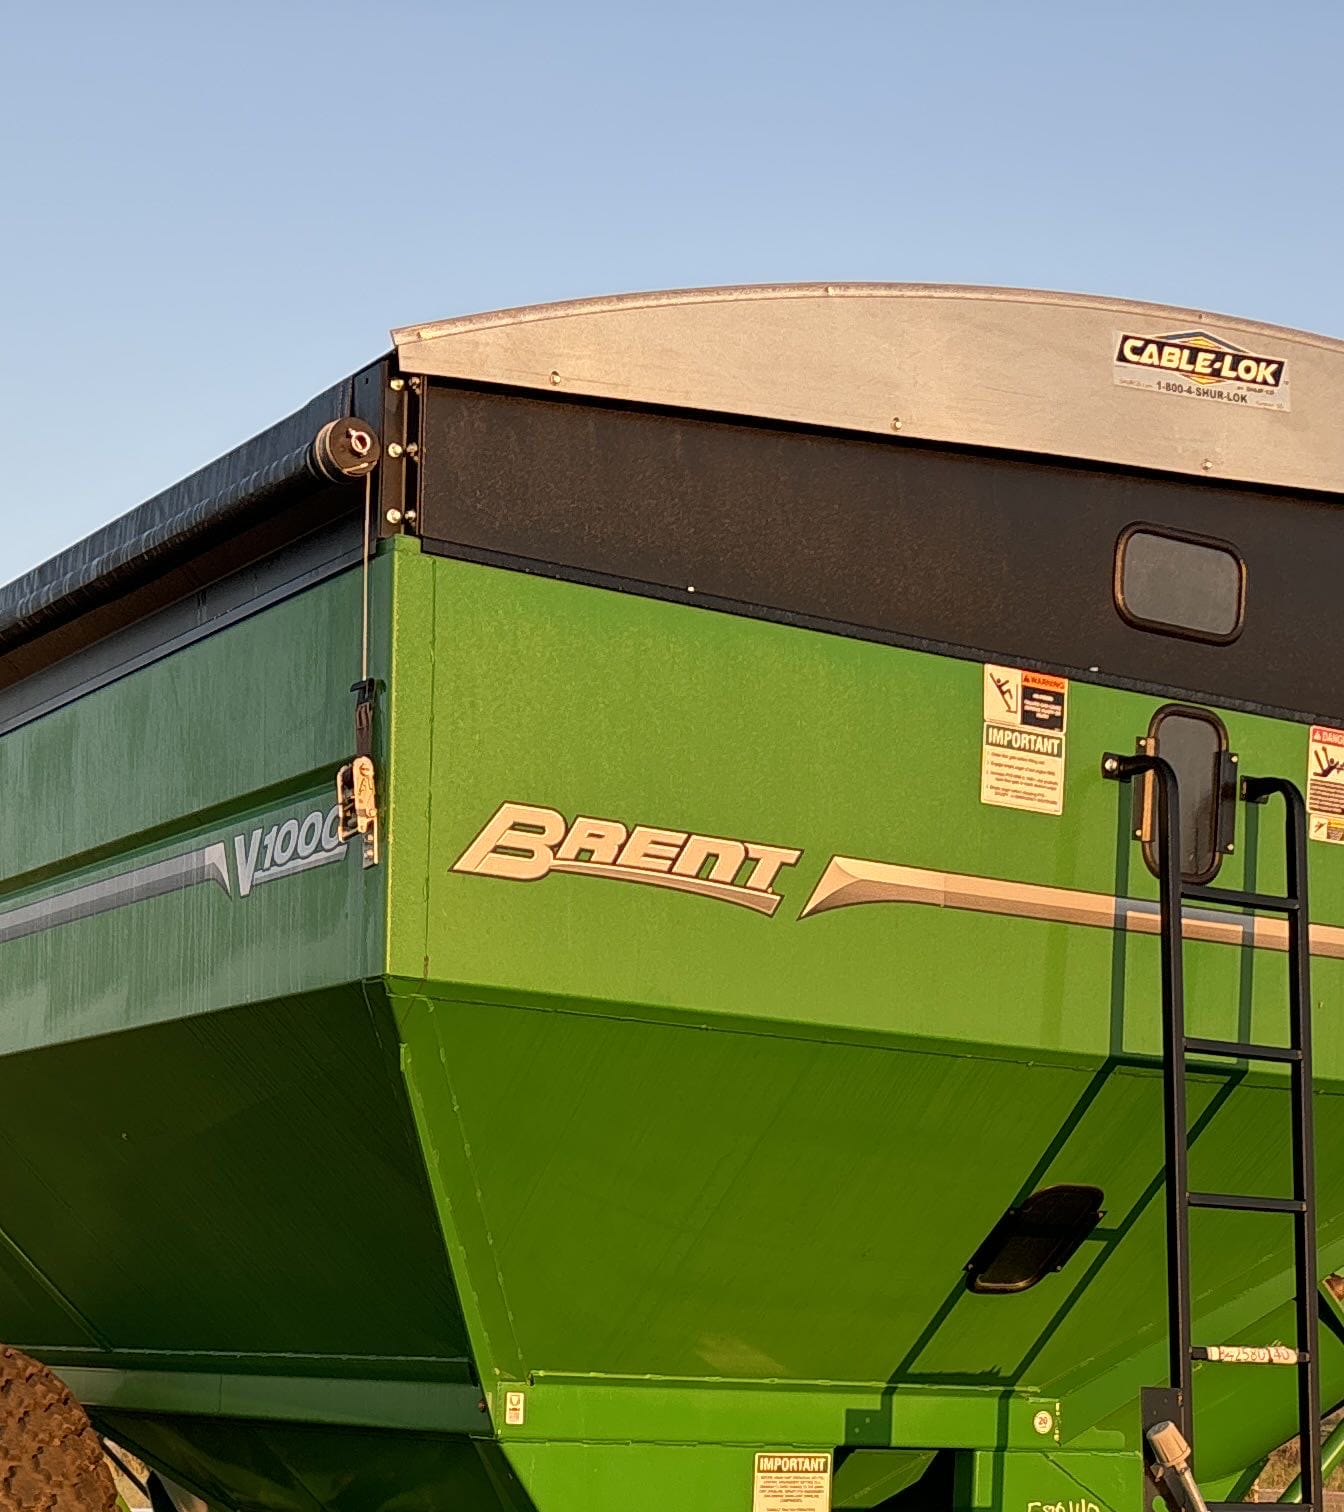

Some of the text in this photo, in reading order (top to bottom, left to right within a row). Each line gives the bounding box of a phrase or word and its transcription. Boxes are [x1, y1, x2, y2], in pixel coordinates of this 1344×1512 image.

[1122, 338, 1278, 385] CABLE-LOK
[1156, 380, 1248, 403] 1-800-4-SHUR-LOK
[988, 727, 1061, 755] IMPORTANT
[447, 800, 805, 894] BRENT
[759, 1457, 826, 1472] IMPORTANT
